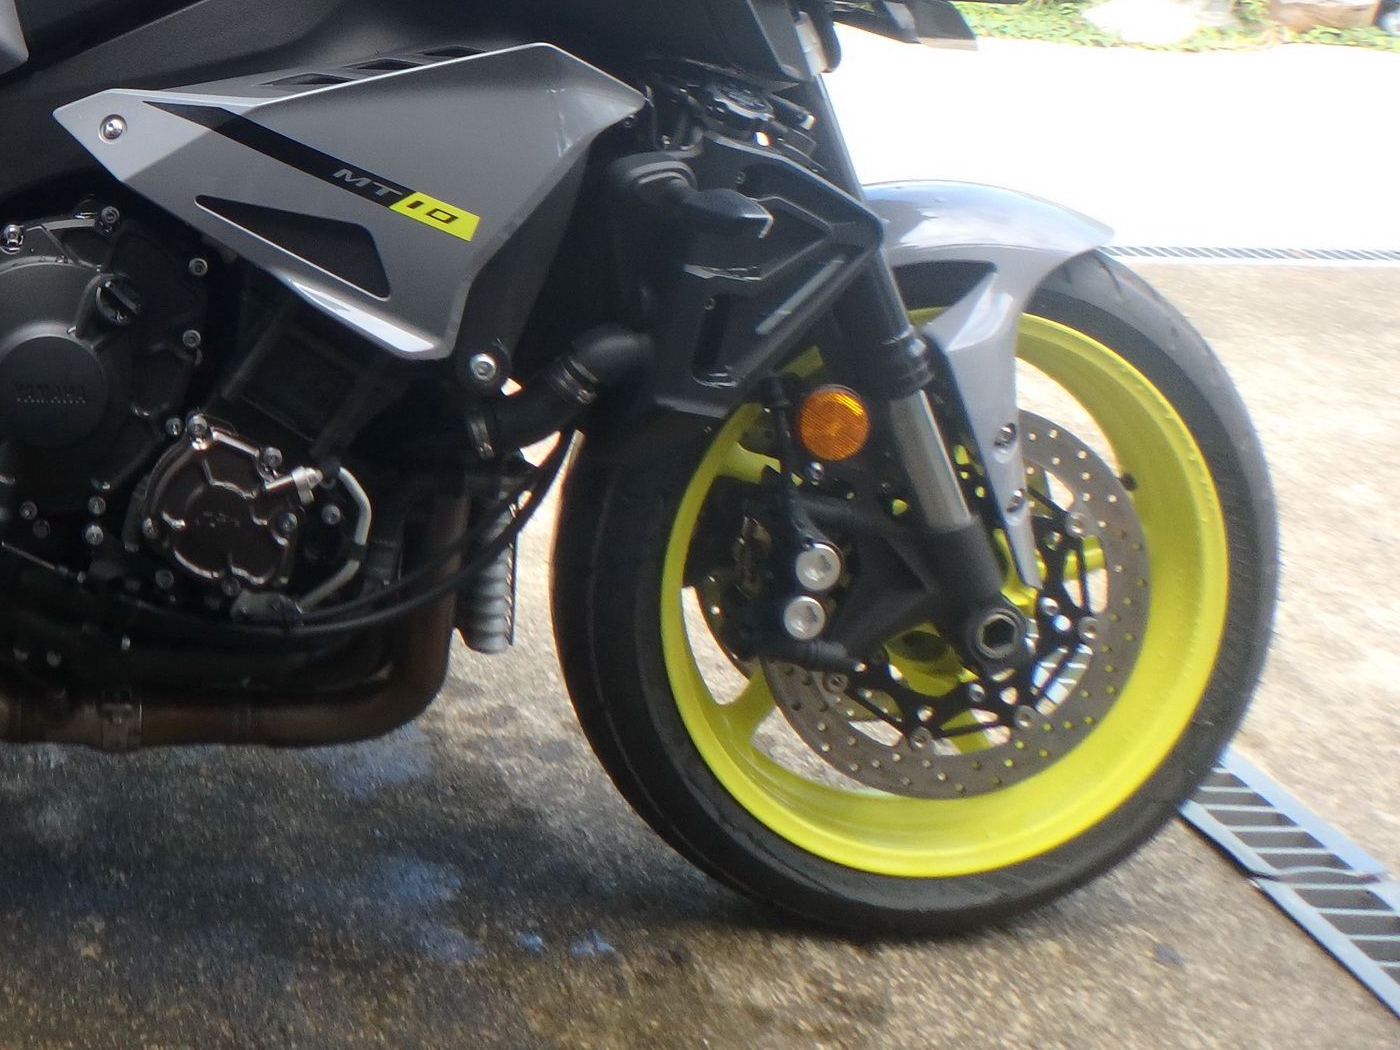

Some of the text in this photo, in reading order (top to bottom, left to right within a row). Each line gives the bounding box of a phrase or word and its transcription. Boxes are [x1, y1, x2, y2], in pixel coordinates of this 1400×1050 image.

[333, 169, 458, 224] MT 10
[13, 383, 87, 404] YAMAHA
